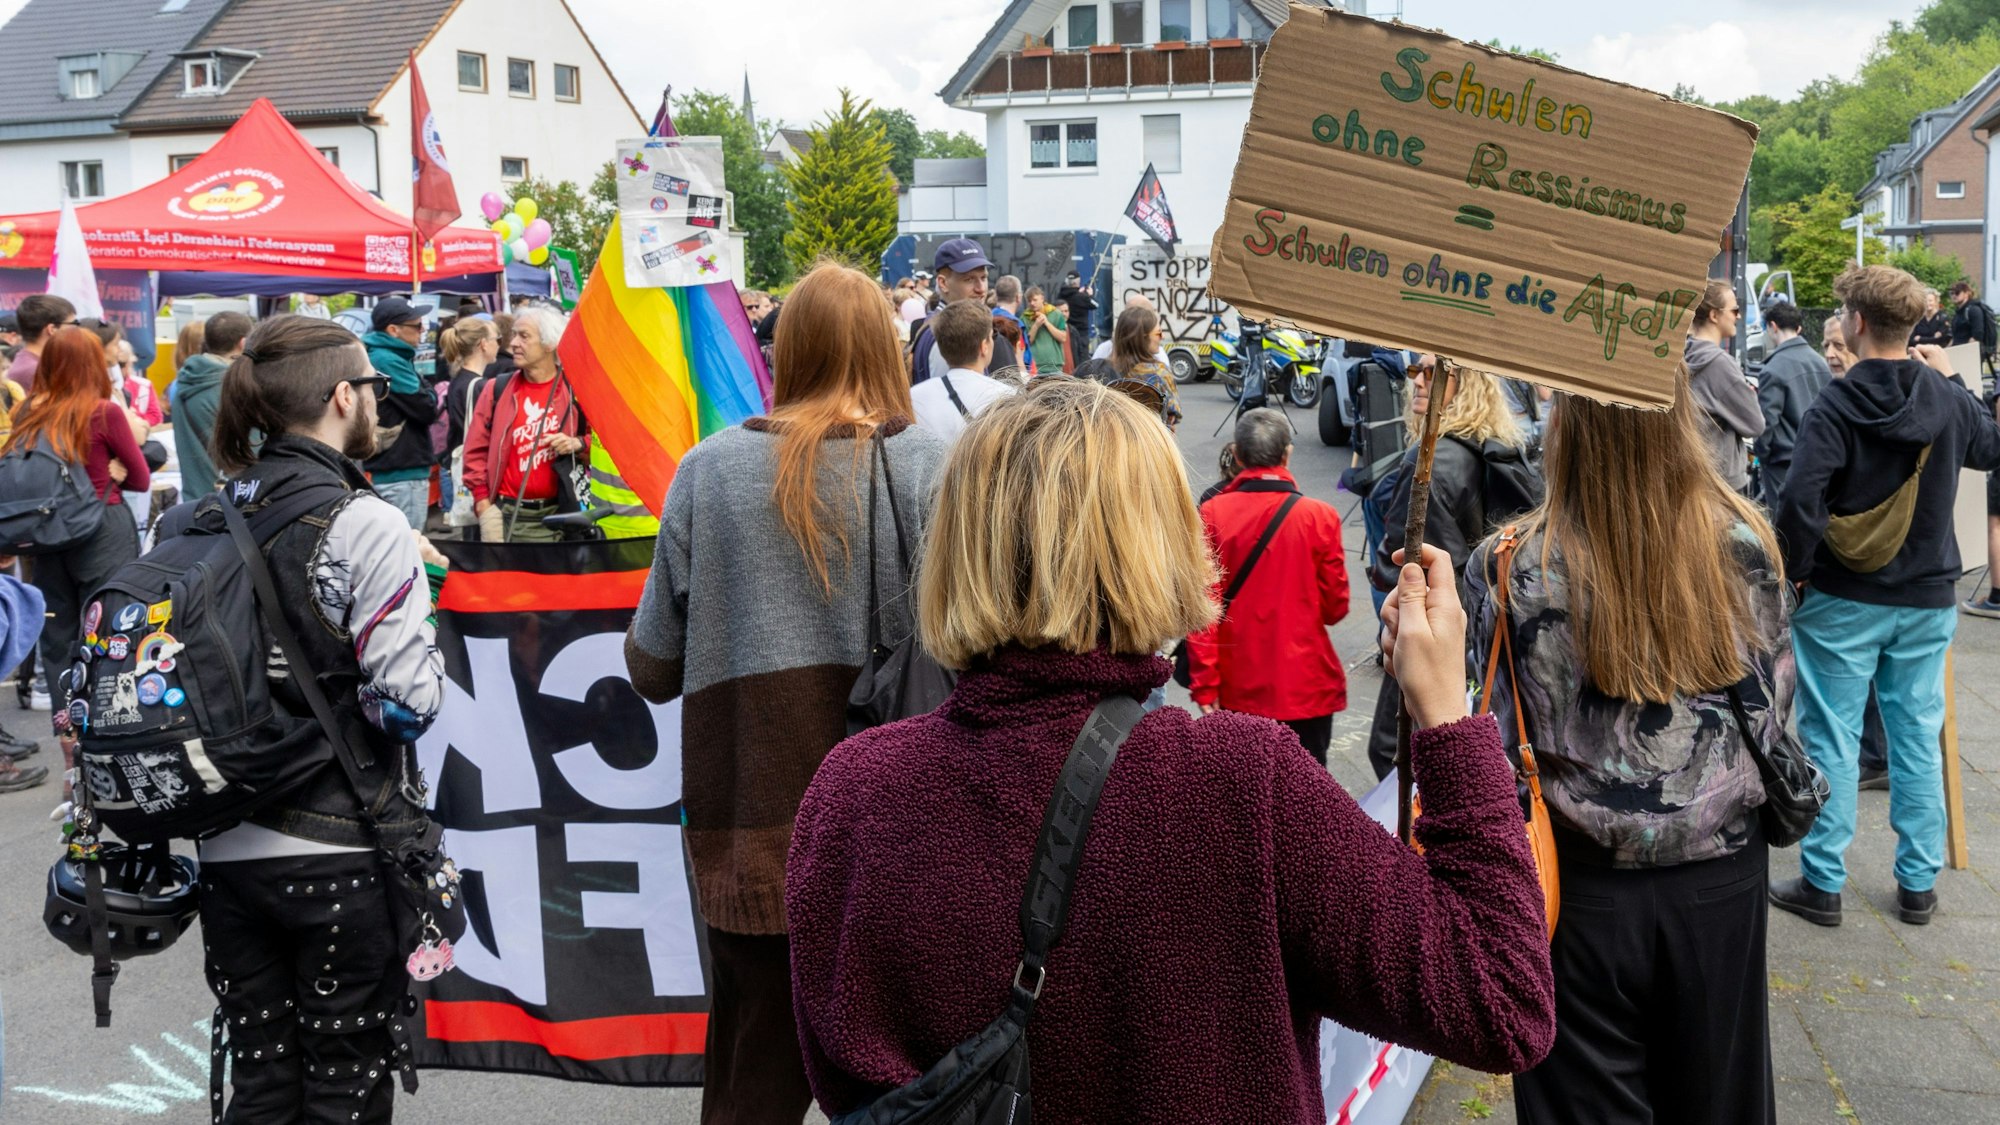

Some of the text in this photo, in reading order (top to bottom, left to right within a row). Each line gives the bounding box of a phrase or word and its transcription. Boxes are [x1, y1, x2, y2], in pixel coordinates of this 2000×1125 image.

[1380, 47, 1592, 139] Schulen
[1312, 109, 1687, 234] ohne Rassismus
[87, 245, 327, 267] deration Demokratischer Arbeitervereine
[247, 236, 336, 254] Federasyonu
[1130, 257, 1209, 281] STOPP
[1165, 279, 1188, 289] DEN
[1243, 208, 1698, 361] Schulen ohne die Afd!
[1158, 314, 1228, 341] AZA
[109, 640, 128, 649] FCK
[109, 648, 128, 657] AFD
[132, 788, 149, 803] IS
